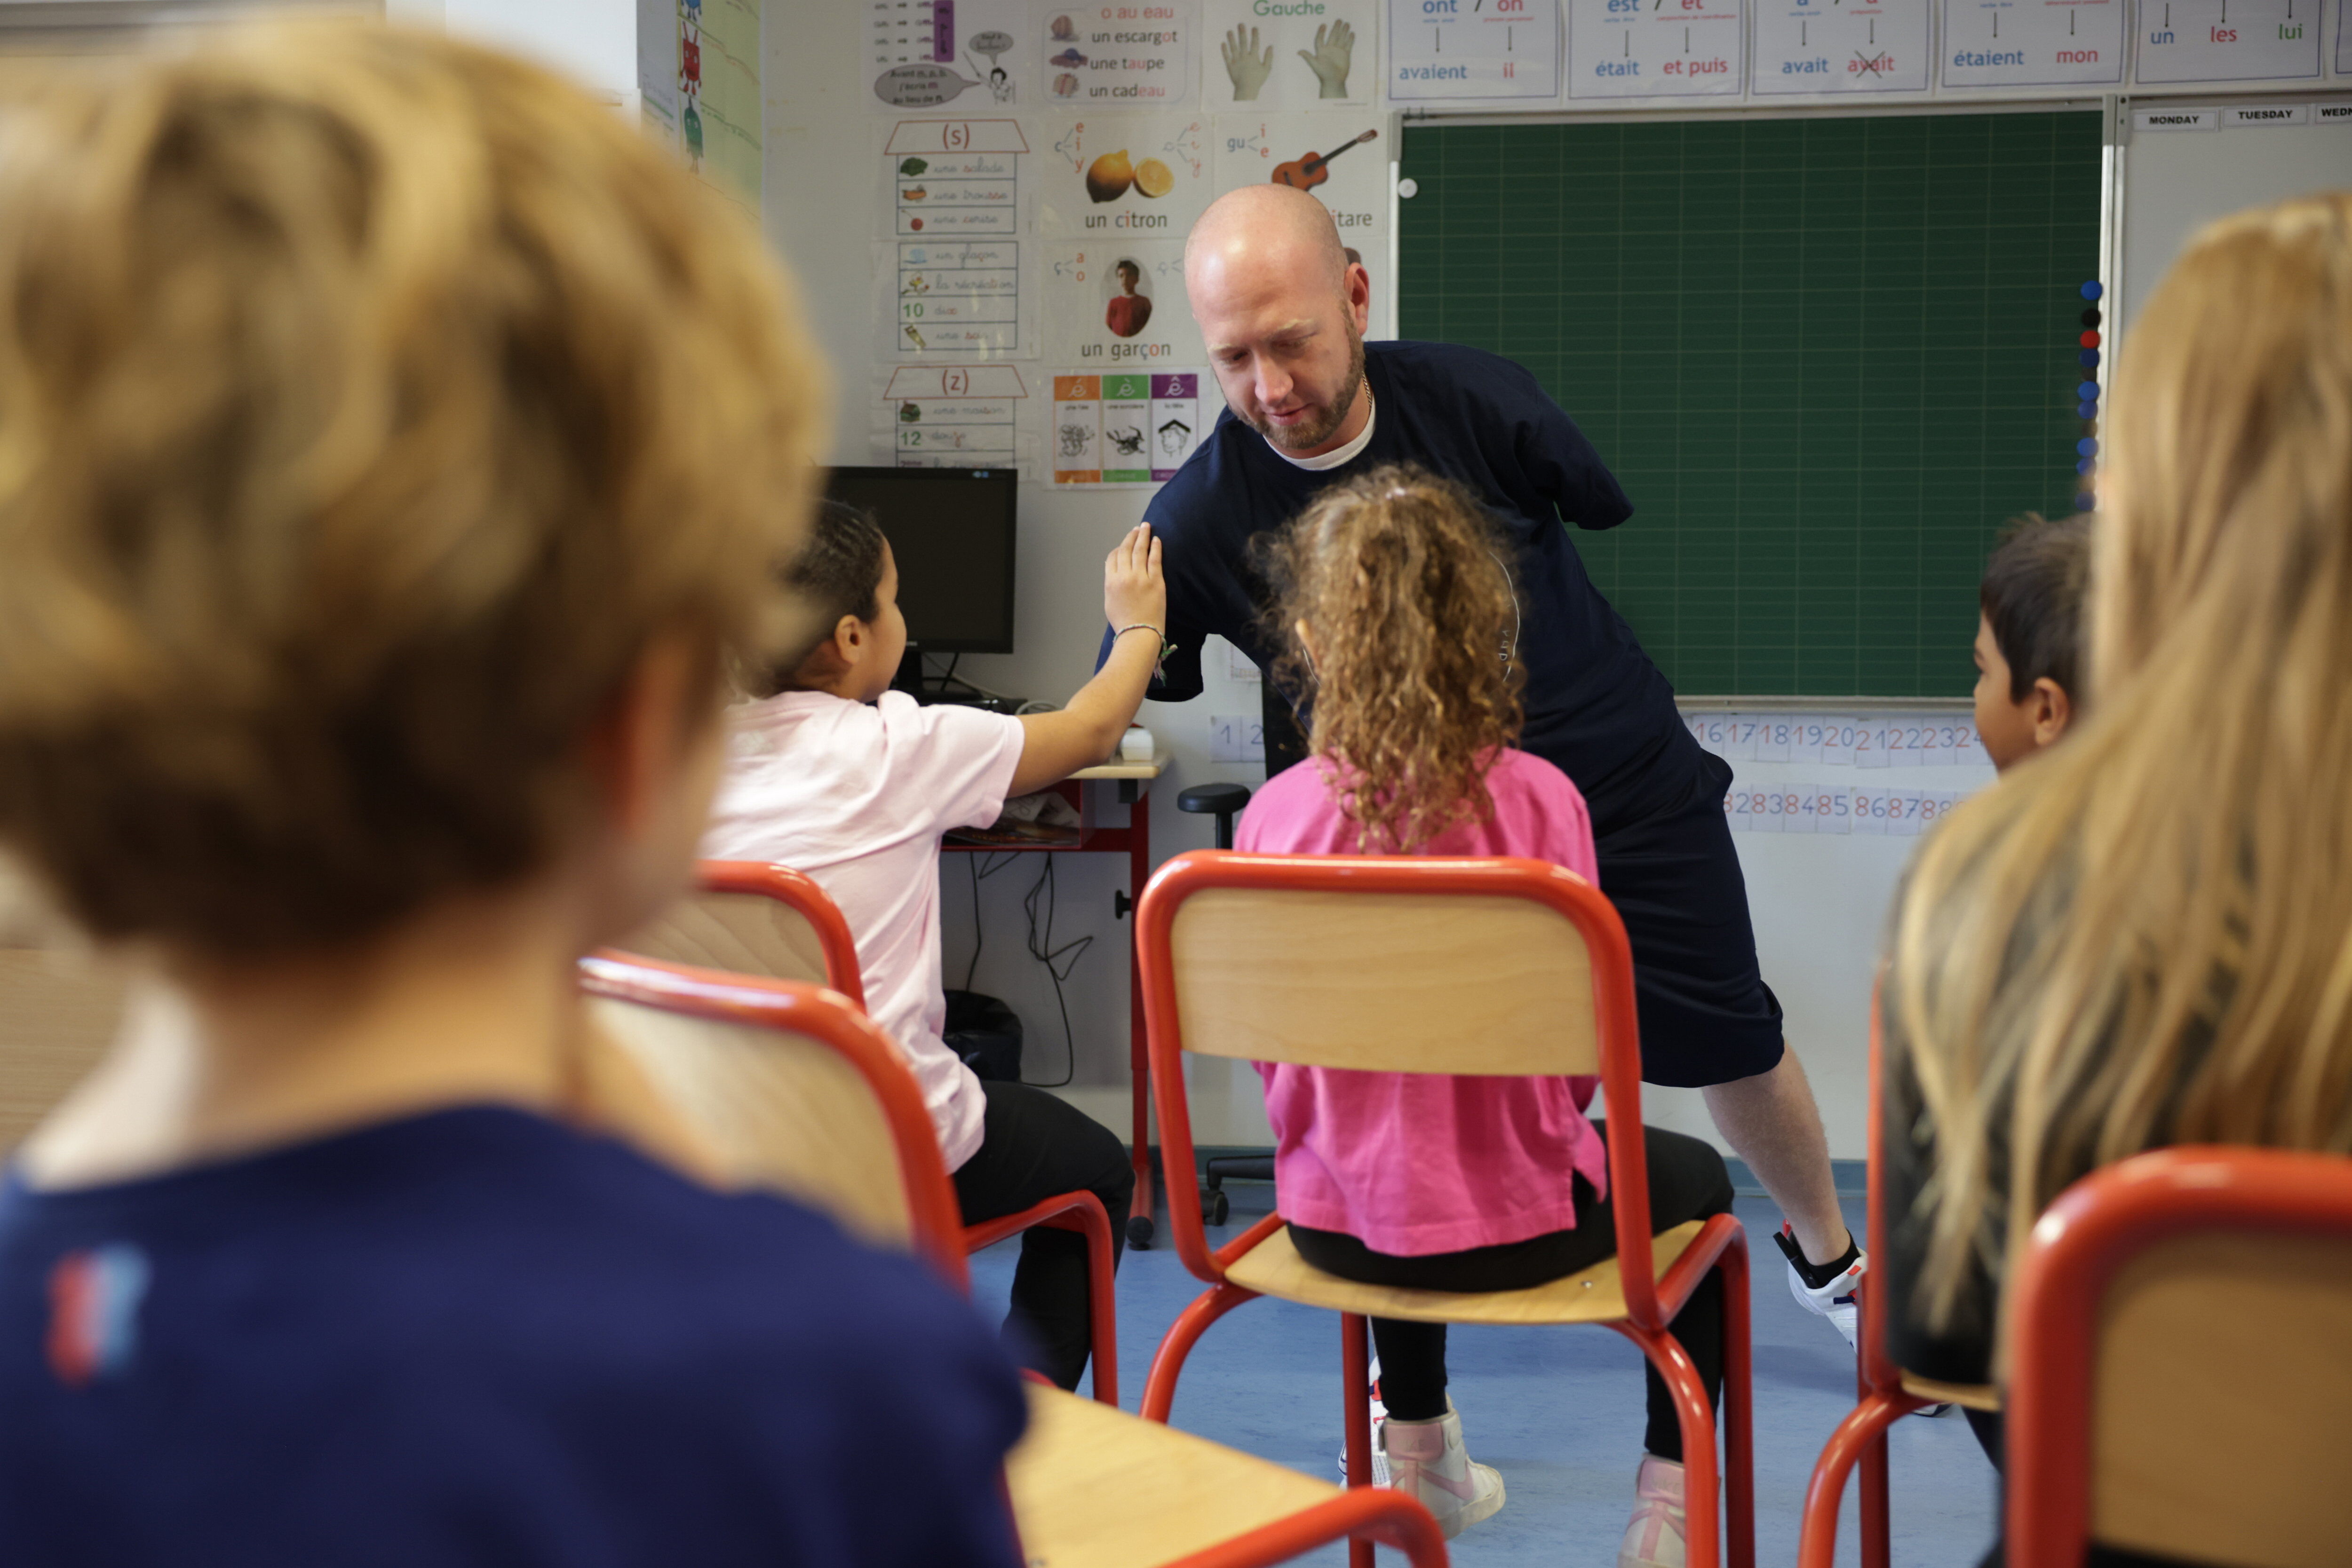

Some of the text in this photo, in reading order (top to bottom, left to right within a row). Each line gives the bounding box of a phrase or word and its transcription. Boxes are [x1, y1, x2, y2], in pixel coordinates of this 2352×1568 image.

[1101, 7, 1174, 19] o au eau
[1253, 0, 1325, 16] Gauche
[1422, 0, 1458, 13] ont
[1497, 0, 1524, 12] on
[1607, 0, 1640, 12] est
[1091, 31, 1178, 46] un escargot
[2150, 24, 2303, 44] un les lui
[1090, 58, 1165, 71] une taupe
[1782, 56, 1895, 74] avait avait
[1954, 49, 2098, 67] étaient mon
[1399, 63, 1514, 80] avaient il
[1596, 57, 1729, 77] était et puis
[1089, 83, 1166, 97] un cadeau
[2149, 116, 2200, 125] MONDAY
[2238, 110, 2293, 119] TUESDAY
[1075, 122, 1084, 133] e
[1261, 123, 1265, 138] i
[1054, 141, 1062, 152] c
[1076, 136, 1081, 150] i
[1227, 138, 1245, 152] gu
[1260, 147, 1270, 158] e
[1075, 158, 1085, 174] y
[1086, 210, 1167, 228] un citron
[1331, 209, 1373, 227] itare
[1076, 253, 1084, 264] a
[1076, 270, 1085, 282] o
[903, 303, 924, 318] 10
[1082, 343, 1171, 361] un garçon
[900, 431, 922, 446] 12
[1221, 724, 1263, 744] 1 2
[1694, 722, 1723, 743] 16
[1726, 723, 1756, 744] 17
[1758, 724, 1788, 745] 18
[1793, 725, 1823, 745] 19
[1824, 726, 1855, 747] 20
[1856, 729, 1885, 751] 21
[1889, 728, 1921, 749] 22
[1922, 727, 1955, 748] 23
[1752, 793, 1783, 815] 83
[1785, 794, 1814, 815] 84
[1817, 795, 1848, 816] 85
[1855, 796, 1886, 817] 86
[1888, 799, 1920, 818] 87
